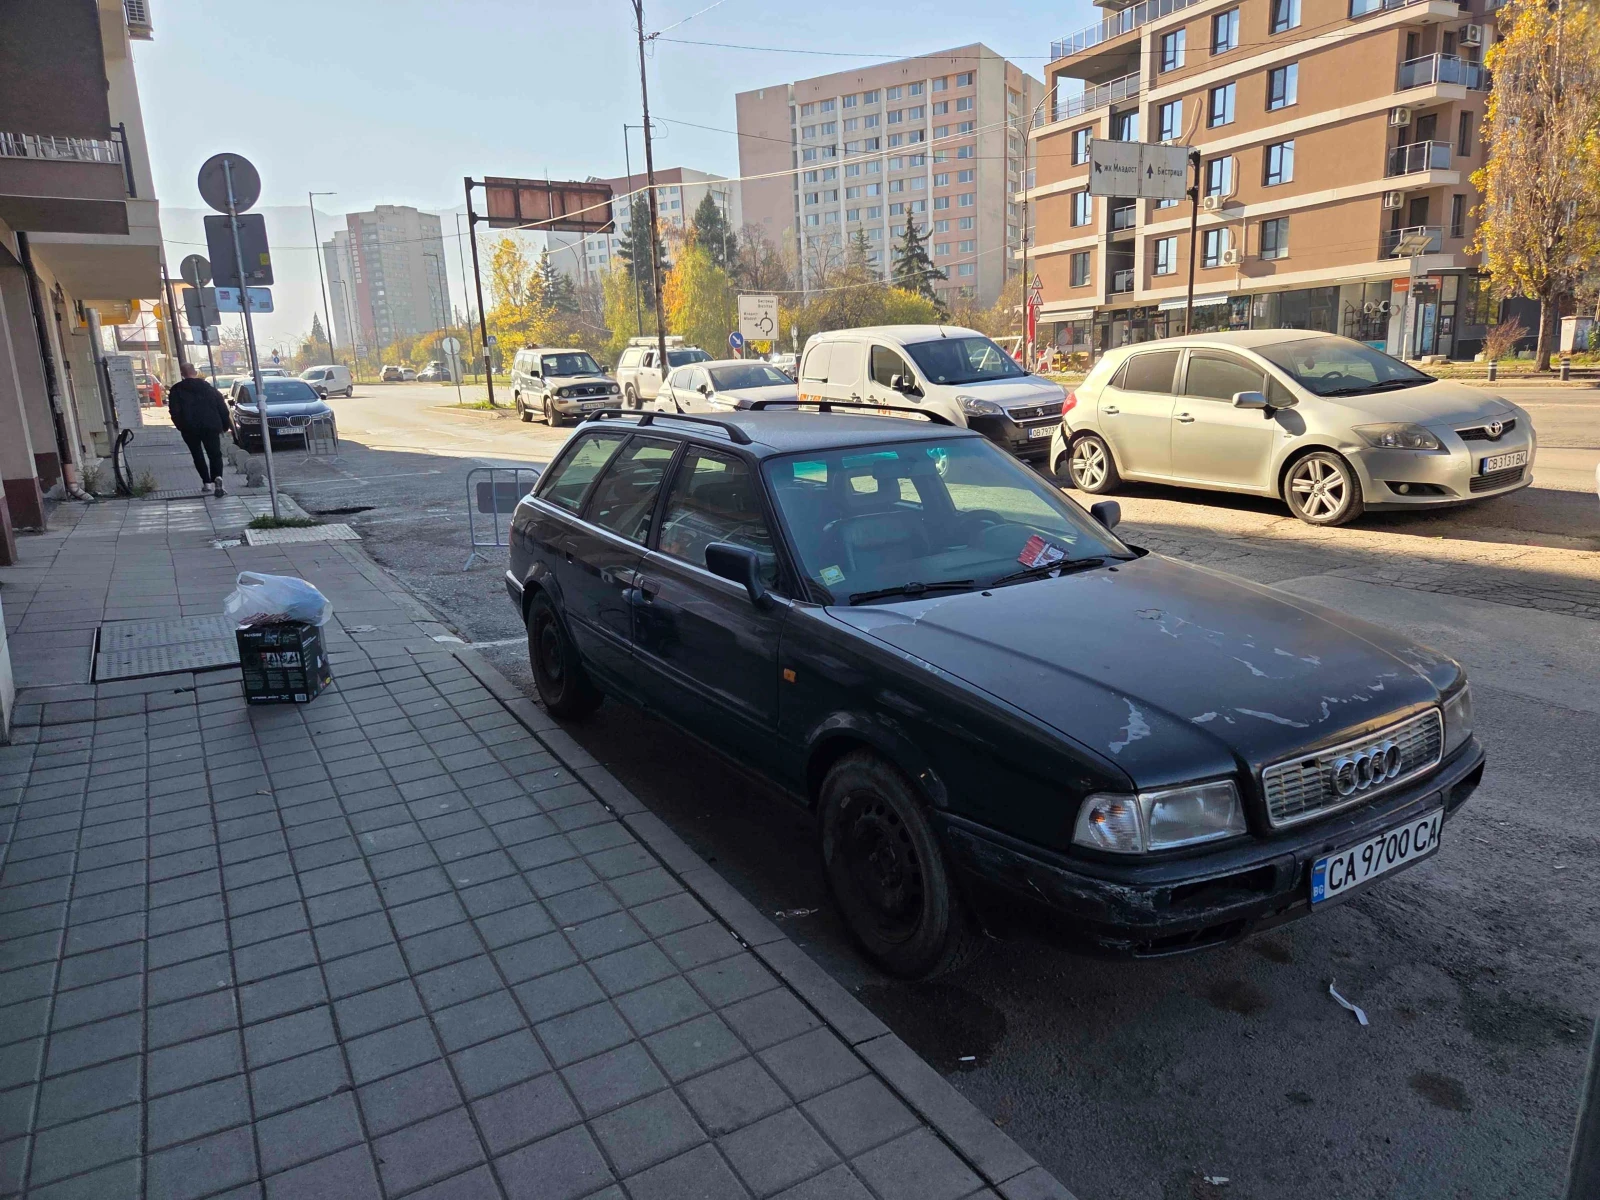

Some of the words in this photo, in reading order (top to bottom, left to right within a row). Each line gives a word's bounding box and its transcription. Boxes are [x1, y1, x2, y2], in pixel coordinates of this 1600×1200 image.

[1103, 164, 1112, 172] жк
[1113, 163, 1137, 173] Младост
[1157, 167, 1183, 177] Бистрица
[1488, 459, 1498, 470] CB
[1499, 455, 1515, 468] 3131
[1516, 453, 1525, 464] BK
[1329, 852, 1356, 890] CA
[1362, 829, 1410, 876] 9700
[1414, 817, 1437, 852] CA
[1312, 885, 1324, 897] BG
